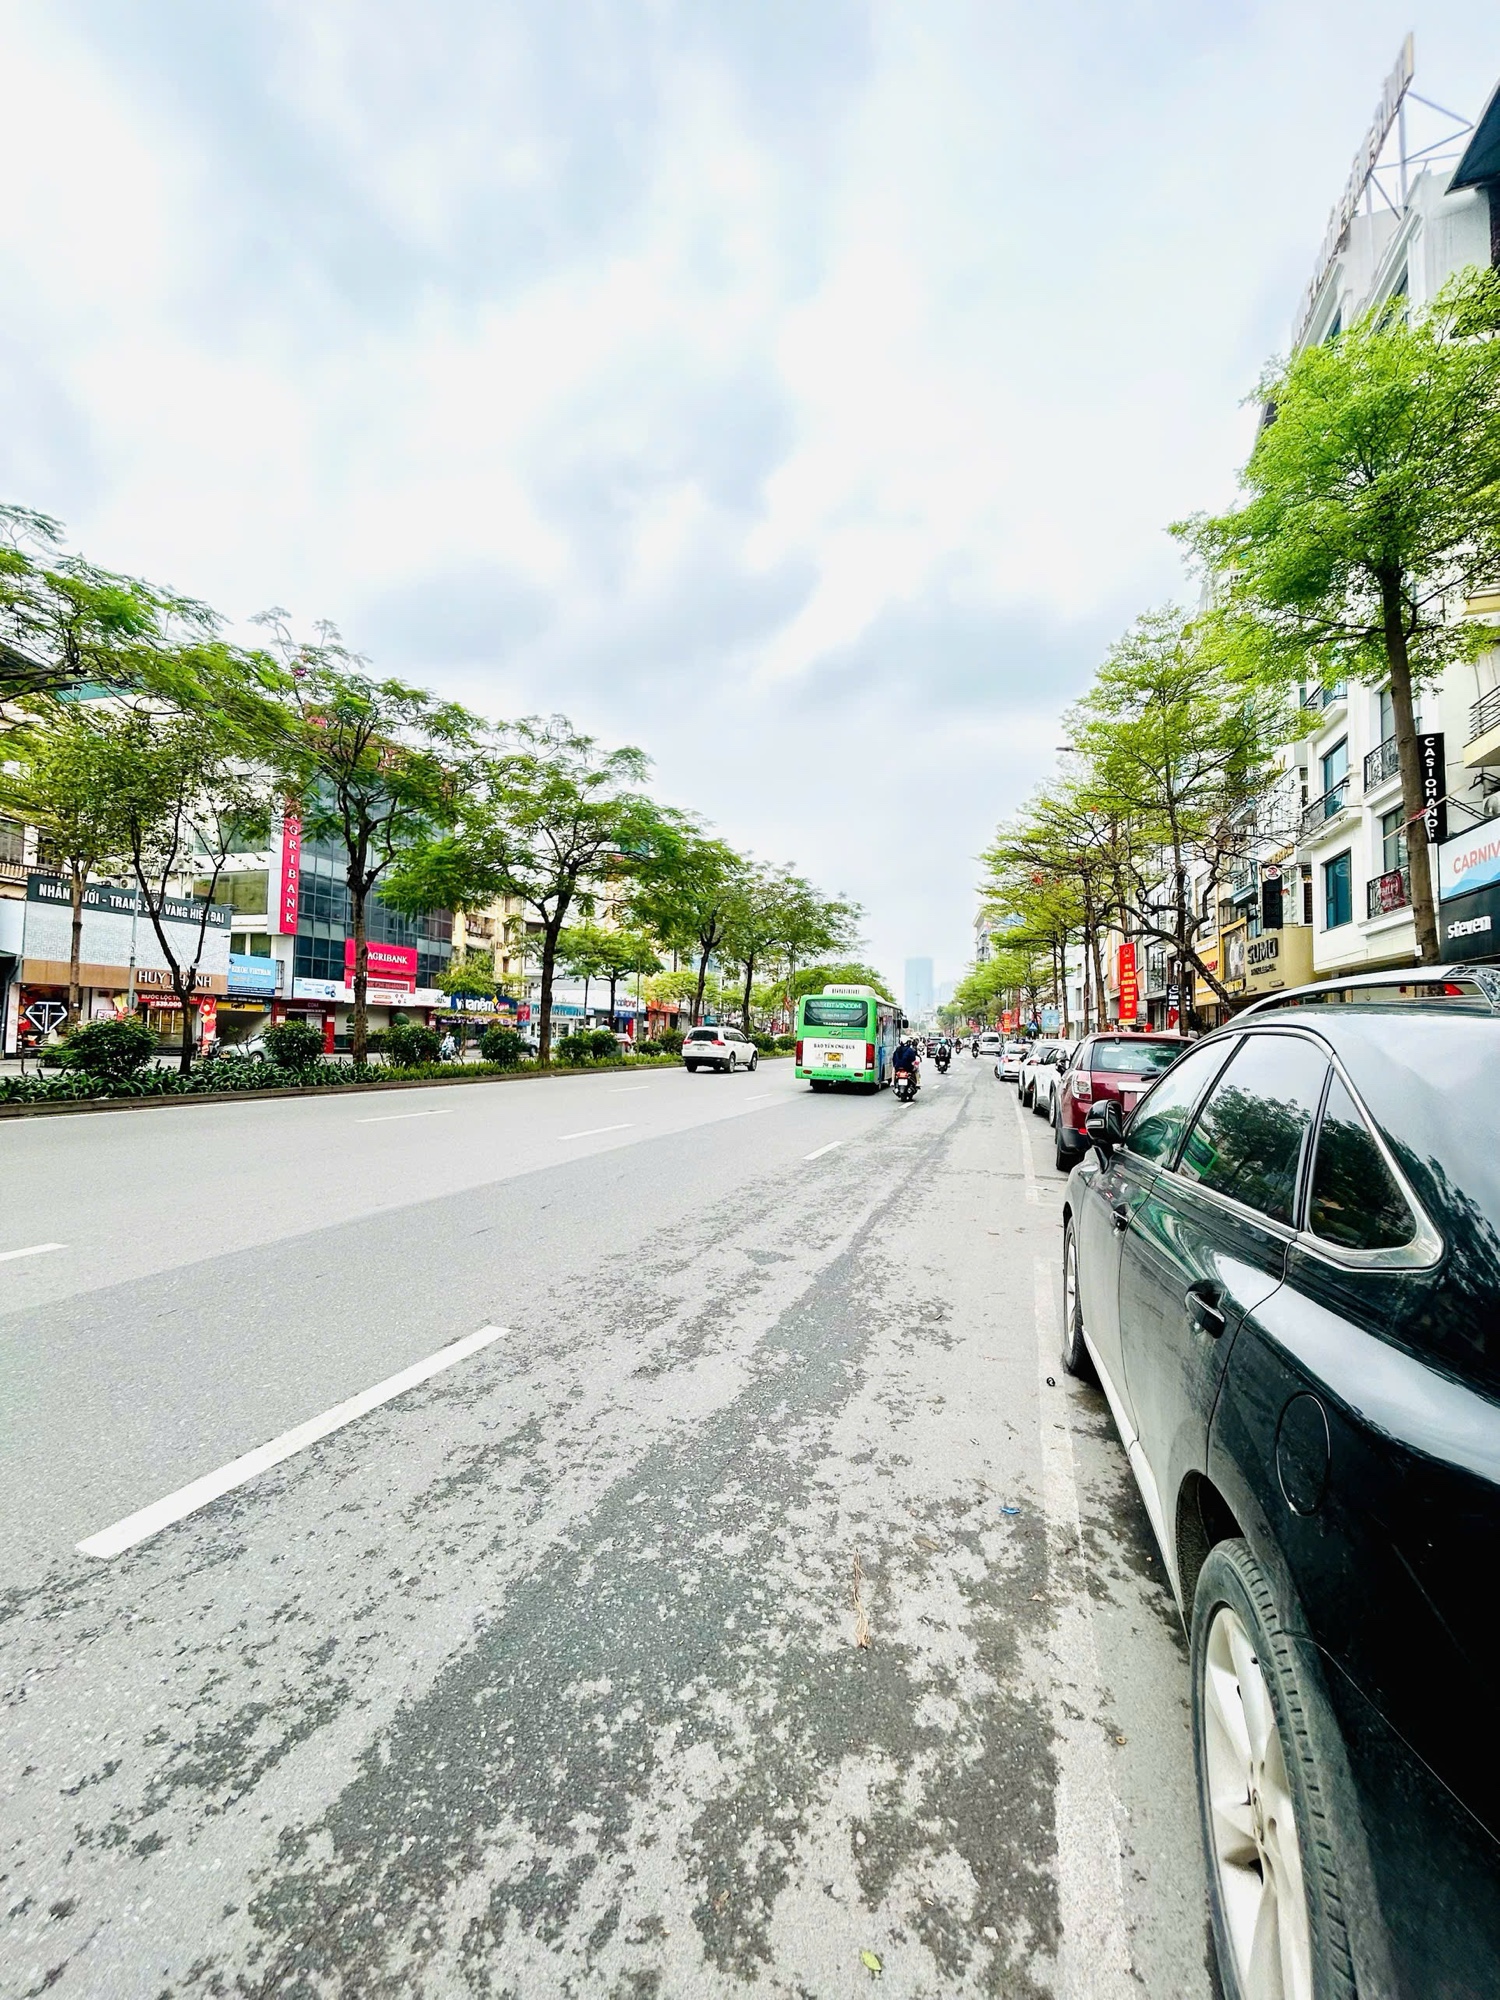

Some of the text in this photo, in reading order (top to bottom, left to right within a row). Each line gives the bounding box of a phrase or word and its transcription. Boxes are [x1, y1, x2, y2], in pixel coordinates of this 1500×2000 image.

[109, 894, 142, 912] TRANG
[165, 901, 188, 918] VÀNG
[1447, 915, 1492, 939] steven
[367, 952, 408, 965] AGRIBANK
[138, 970, 166, 985] HUY
